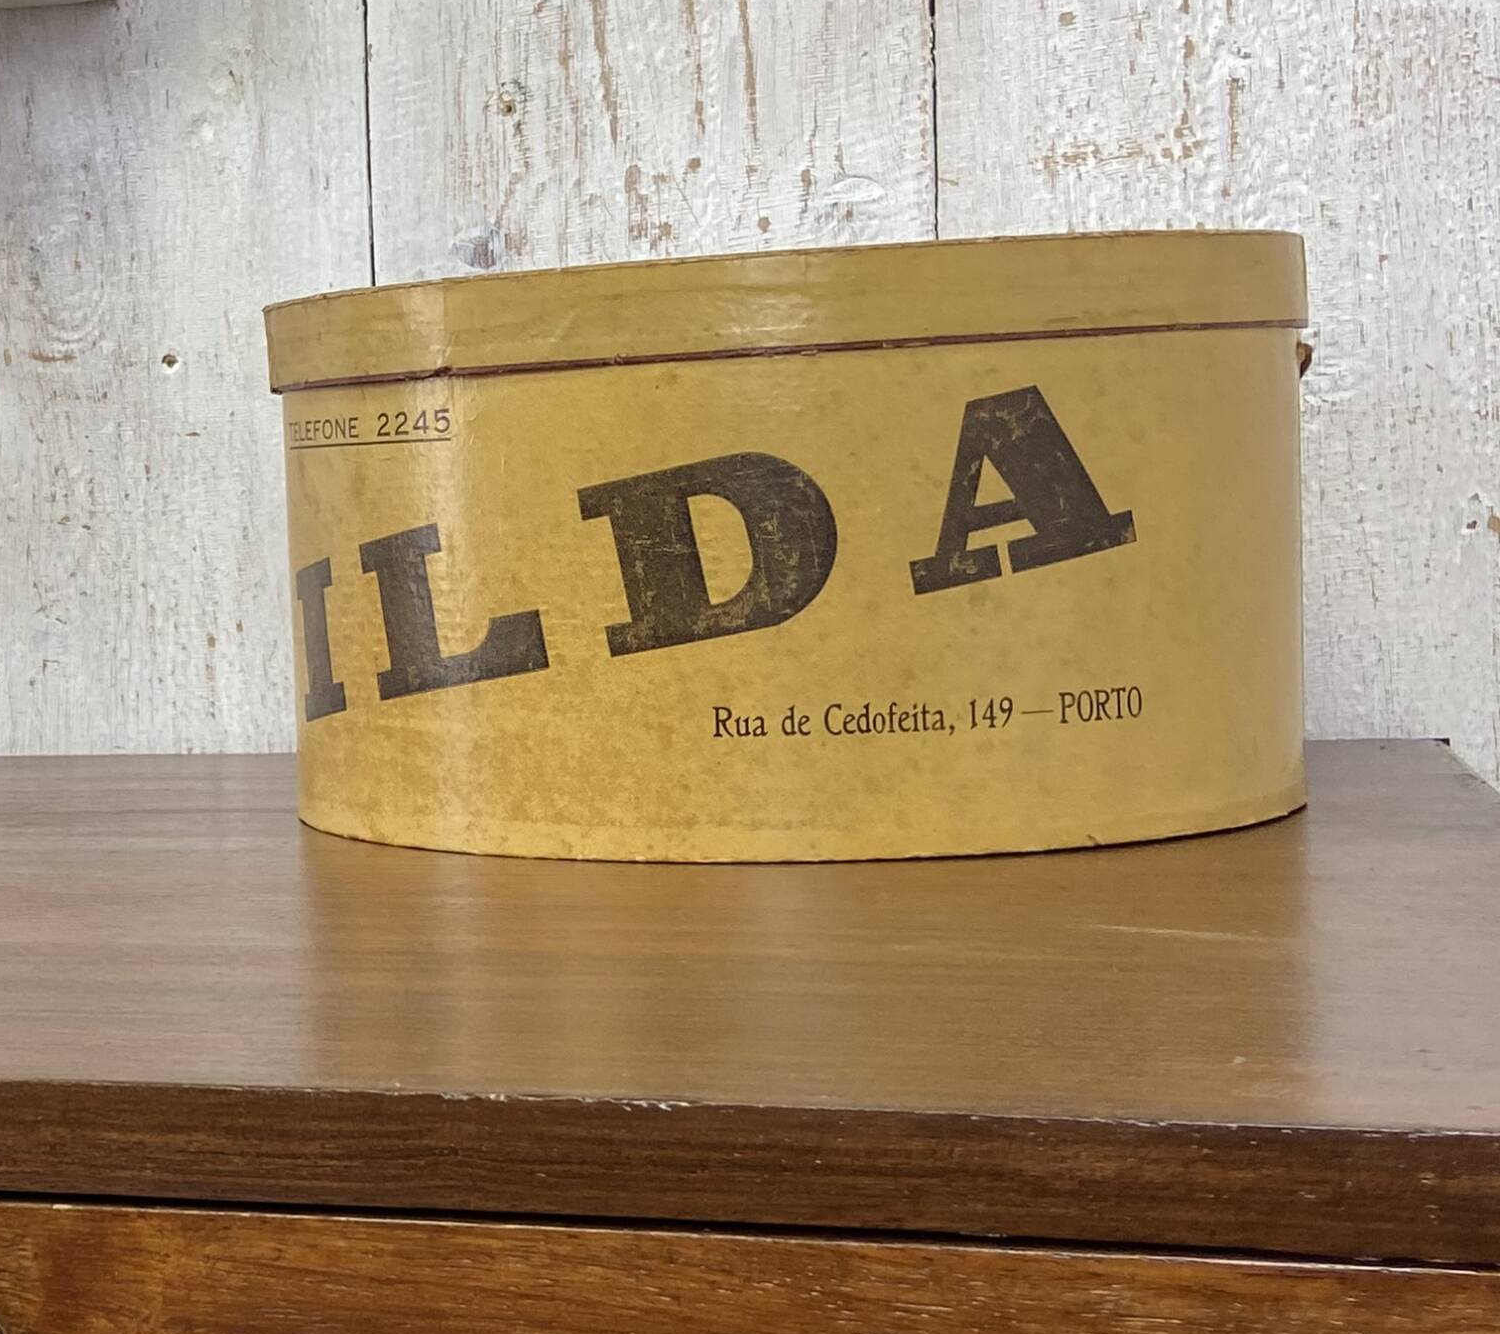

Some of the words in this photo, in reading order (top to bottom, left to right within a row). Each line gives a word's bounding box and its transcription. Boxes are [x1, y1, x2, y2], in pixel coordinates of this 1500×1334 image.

[376, 408, 451, 437] 2245
[712, 706, 769, 738] Rua
[781, 705, 811, 736] de
[823, 701, 957, 736] Cedofeita,
